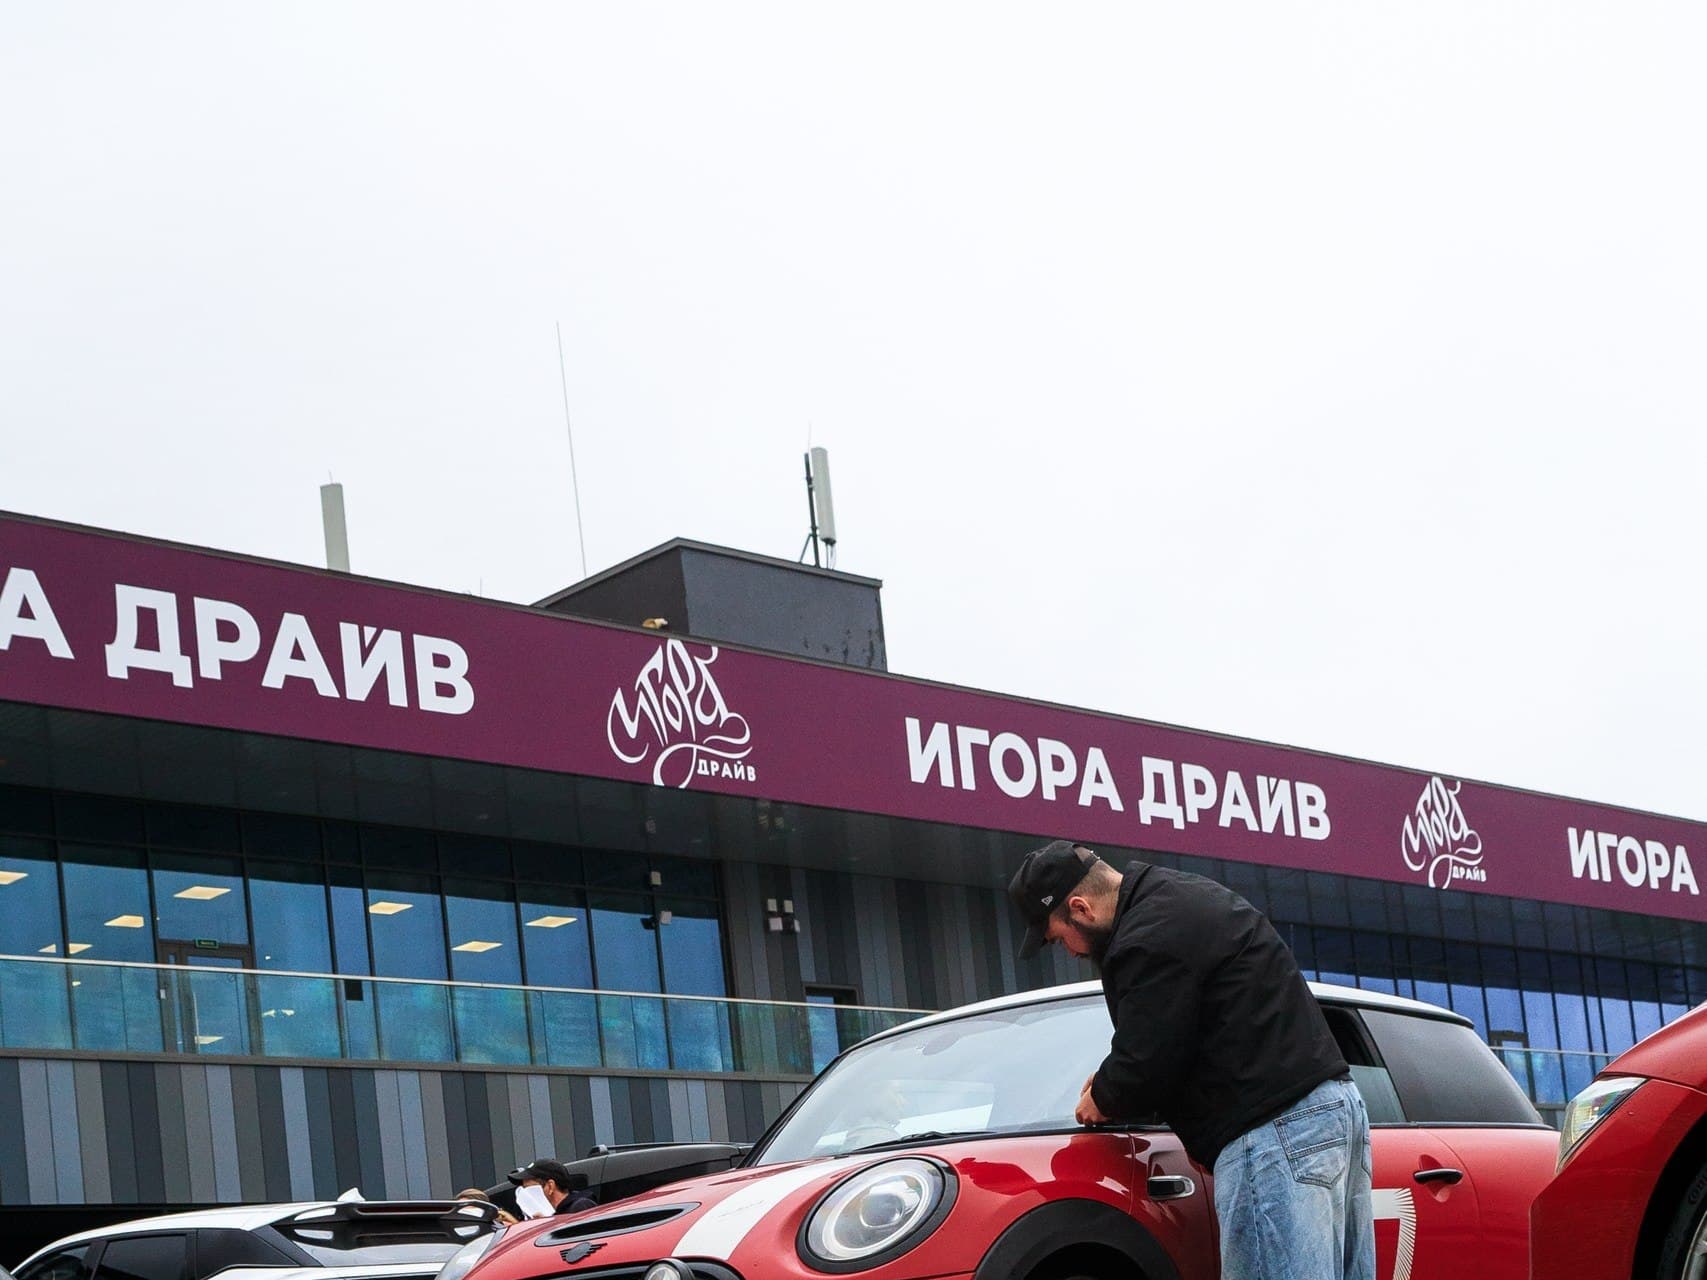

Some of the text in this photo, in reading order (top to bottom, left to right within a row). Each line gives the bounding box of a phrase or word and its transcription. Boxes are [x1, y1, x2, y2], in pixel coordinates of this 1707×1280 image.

[104, 583, 475, 715] ДРАЙВ
[697, 758, 757, 782] ДРАЙВ
[905, 716, 1331, 841] ИГОРА ДРАЙВ
[1452, 865, 1487, 882] ДРАЙВ
[1567, 827, 1700, 895] ИГОРА
